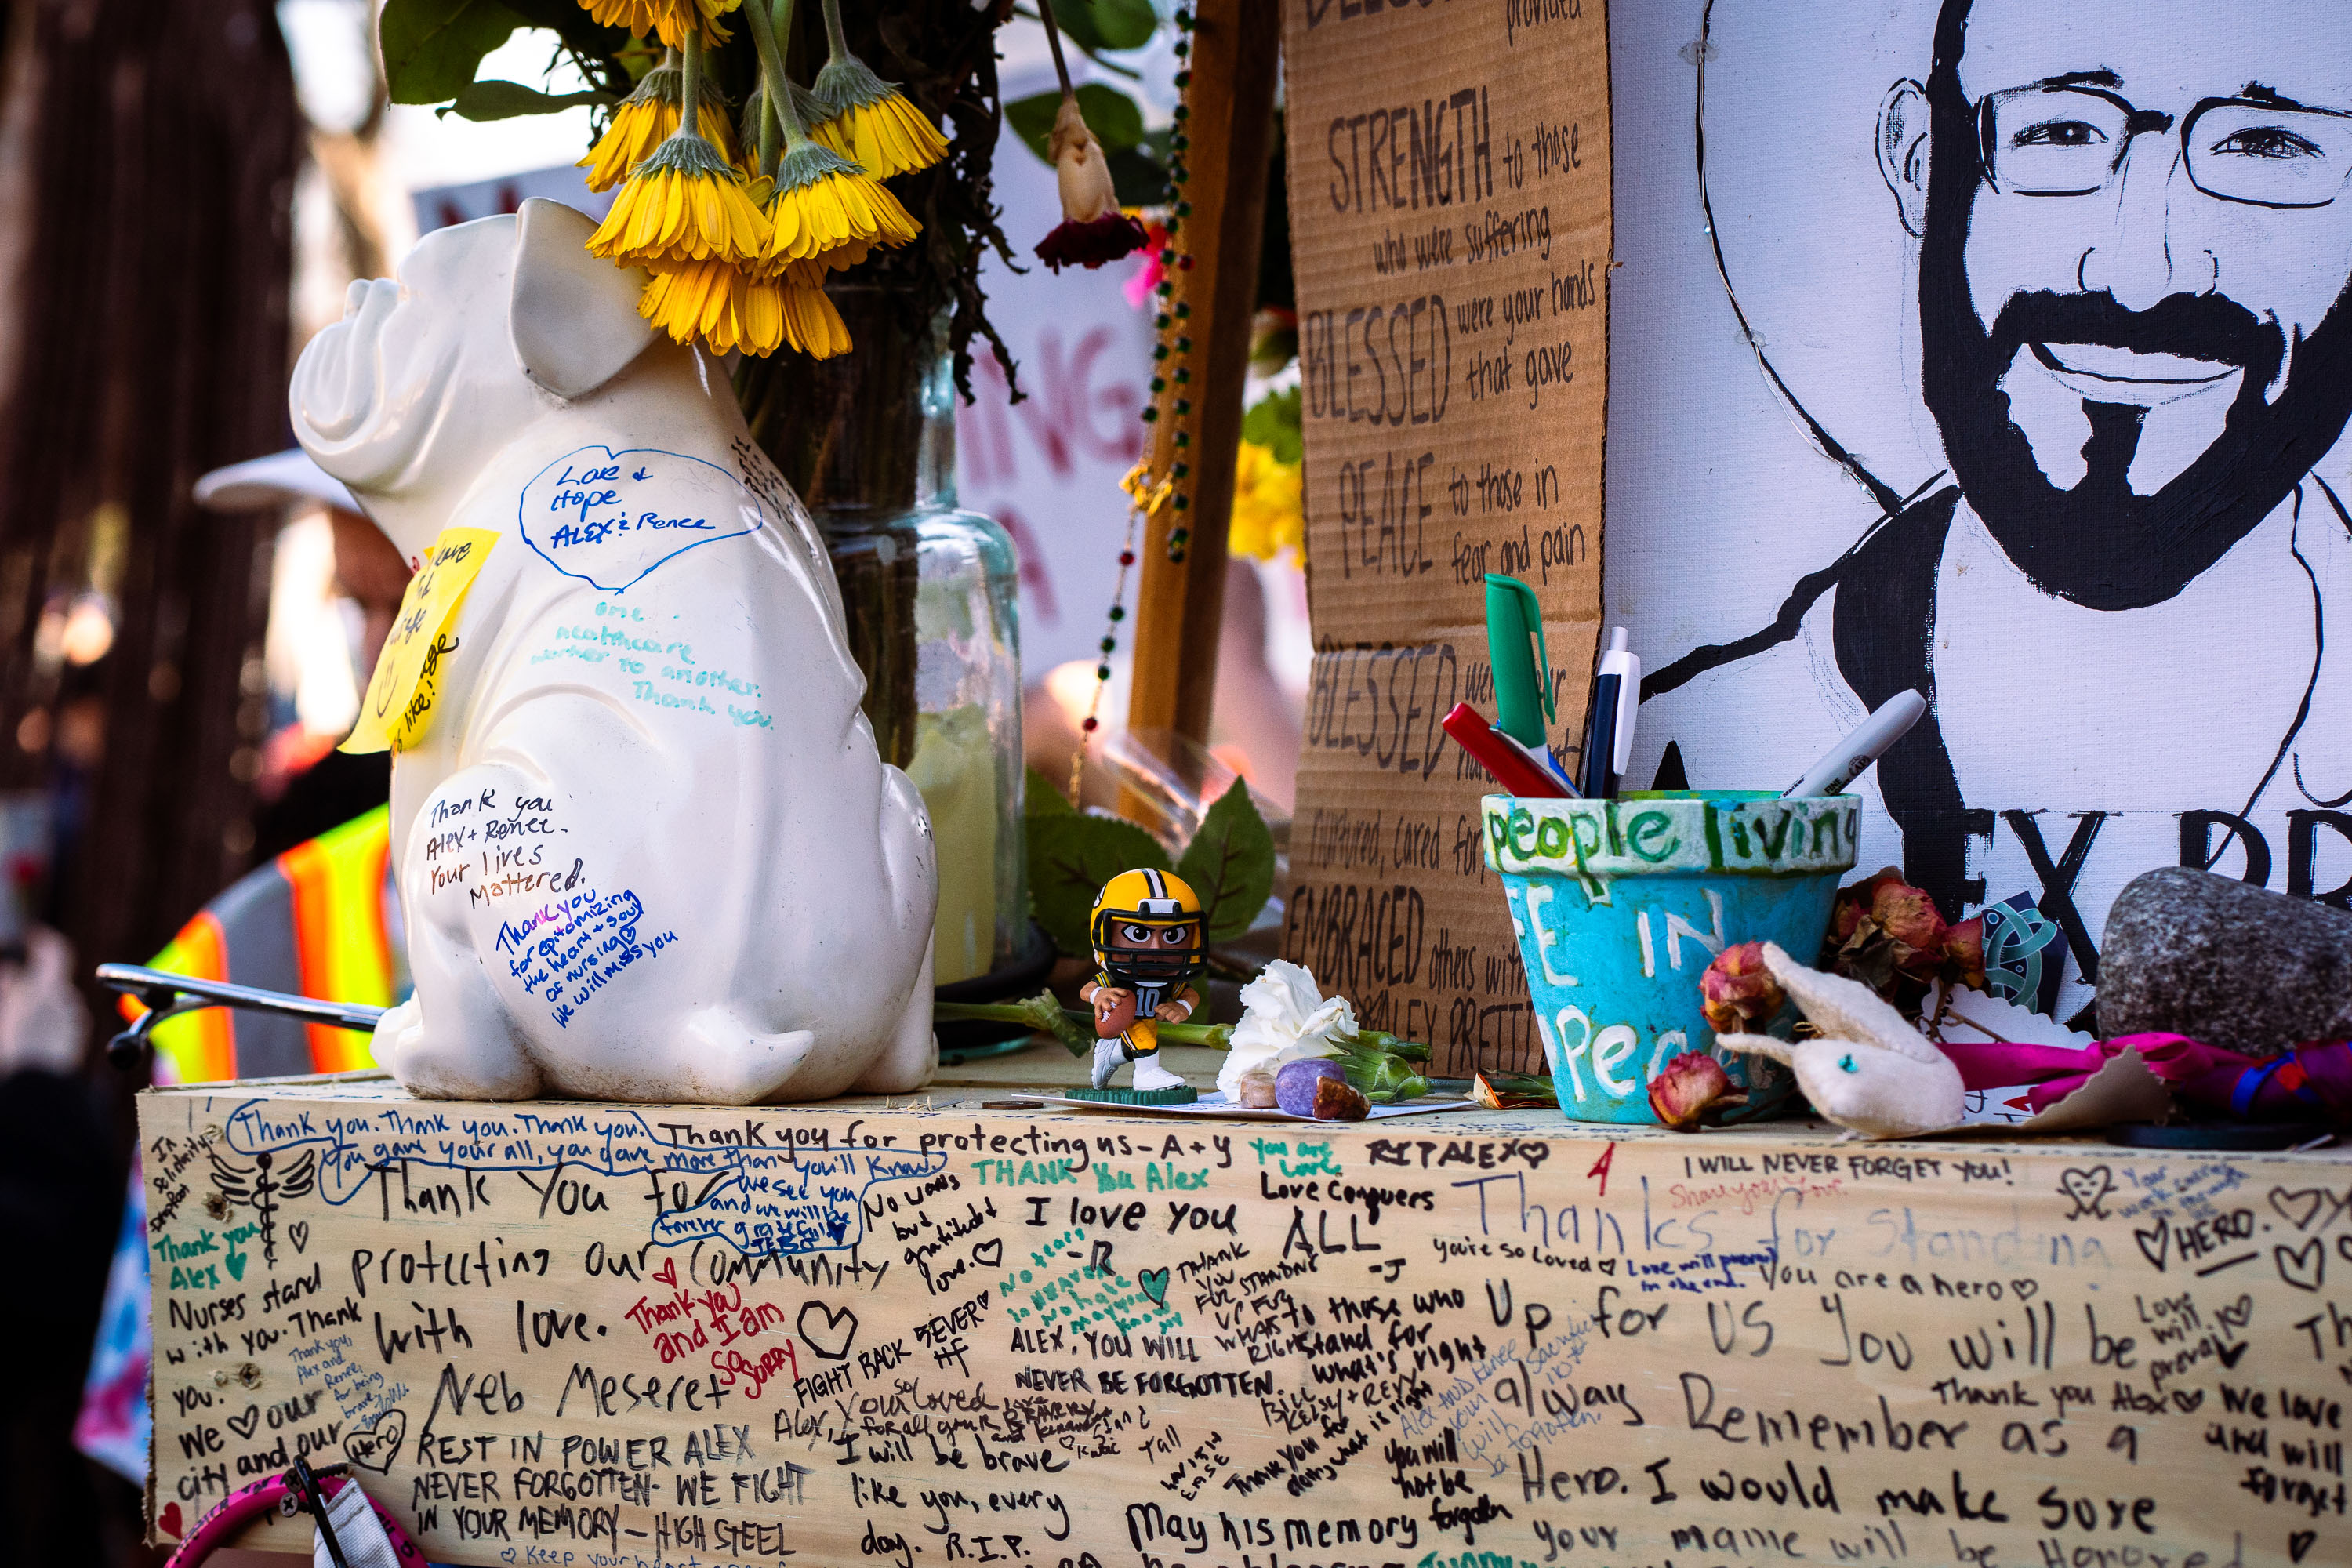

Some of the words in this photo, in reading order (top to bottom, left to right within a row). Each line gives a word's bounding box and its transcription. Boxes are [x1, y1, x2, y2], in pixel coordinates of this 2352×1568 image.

[1328, 85, 1493, 214] STRENGTH
[1504, 131, 1523, 189] to
[1531, 122, 1581, 179] those
[1374, 229, 1406, 275] who
[1415, 227, 1453, 271] were
[1466, 206, 1552, 260] suffering
[1307, 294, 1450, 426] BLESSED
[1457, 295, 1494, 336] were
[1504, 285, 1544, 345] your
[1552, 260, 1595, 315] hands
[1466, 350, 1512, 401] that
[1526, 341, 1573, 410] gave
[557, 466, 619, 486] Love
[551, 488, 623, 522] Hope
[1339, 452, 1434, 579] PEACE
[1449, 466, 1468, 516] to
[1476, 463, 1522, 512] those
[1534, 457, 1559, 510] in
[551, 520, 613, 549] ALEX
[1452, 531, 1491, 585] fear
[1501, 525, 1530, 575] and
[1541, 521, 1584, 586] pain
[633, 681, 715, 715] Thank
[1310, 634, 1457, 782] BLESSED
[1824, 777, 1842, 794] FINE
[431, 788, 495, 828] Thank
[508, 794, 553, 822] you
[426, 826, 465, 861] Alex
[482, 844, 543, 875] lives
[1394, 815, 1441, 870] cared
[1488, 805, 1681, 896] people
[1704, 797, 1858, 868] living
[470, 858, 585, 909] Mattered.
[495, 903, 559, 955] Thank
[539, 889, 642, 959] epitomizing
[1286, 884, 1424, 992] EMBRACED
[1428, 928, 1476, 996] others
[1637, 887, 1726, 978] IN
[551, 931, 592, 973] heart
[567, 935, 627, 986] nursing
[552, 1004, 575, 1029] We
[575, 975, 607, 1006] will
[604, 945, 644, 979] miss
[642, 931, 679, 959] you
[1137, 988, 1160, 1018] 10
[235, 1110, 316, 1147] Thank
[376, 1110, 450, 1134] Thank
[514, 1113, 588, 1135] Thank
[658, 1118, 765, 1149] Thank
[776, 1126, 829, 1163] you
[841, 1119, 898, 1149] for
[920, 1120, 1091, 1173] protecting
[505, 1139, 542, 1165] all,
[1698, 1156, 1754, 1175] WILL
[1761, 1153, 1839, 1175] NEVER
[1847, 1156, 1942, 1181] FORGET
[365, 1159, 493, 1221] Thank
[517, 1161, 609, 1219] You
[771, 1179, 810, 1201] see
[820, 1185, 858, 1210] you
[971, 1158, 1079, 1188] THANK
[1145, 1161, 1210, 1192] Alex
[1261, 1171, 1320, 1202] Love
[710, 1194, 751, 1214] and
[784, 1205, 820, 1220] will
[863, 1193, 898, 1232] No
[1025, 1197, 1052, 1226] I
[1070, 1195, 1146, 1231] love
[153, 1229, 220, 1263] Thank
[1282, 1205, 1381, 1259] ALL
[2174, 1208, 2271, 1261] HERO.
[168, 1292, 247, 1330] Nurses
[263, 1261, 322, 1315] stand
[170, 1264, 221, 1290] Alex
[1835, 1269, 1889, 1288] are
[1933, 1273, 2004, 1301] hero
[289, 1298, 363, 1339] Thank
[1412, 1288, 1465, 1315] who
[372, 1298, 474, 1367] with
[516, 1298, 608, 1354] love.
[1010, 1327, 1077, 1357] ALEX,
[1091, 1327, 1133, 1359] YOU
[1142, 1335, 1202, 1363] WILL
[1388, 1319, 1432, 1350] for
[1594, 1284, 1670, 1340] for
[1949, 1298, 2055, 1370] will
[2085, 1303, 2136, 1367] be
[793, 1361, 857, 1410] FIGHT
[857, 1338, 913, 1380] BACK
[1413, 1334, 1486, 1374] right
[172, 1385, 226, 1420] you.
[1016, 1370, 1091, 1396] NEVER
[1100, 1372, 1128, 1396] BE
[1135, 1370, 1286, 1399] FORGOTTEN.
[1931, 1377, 2040, 1407] Thank
[2049, 1384, 2096, 1418] you
[176, 1424, 225, 1461] We
[266, 1390, 326, 1436] our
[1679, 1370, 1969, 1454] Remember
[2002, 1418, 2068, 1457] as
[2279, 1387, 2343, 1430] love
[237, 1437, 290, 1477] and
[296, 1420, 343, 1463] our
[416, 1428, 487, 1468] REST
[511, 1432, 543, 1463] IN
[562, 1435, 672, 1472] POWER
[684, 1424, 755, 1469] ALEX
[869, 1434, 915, 1464] will
[933, 1436, 969, 1470] be
[980, 1439, 1070, 1475] brave
[2281, 1439, 2343, 1476] will
[412, 1470, 500, 1512] NEVER
[675, 1472, 720, 1507] WE
[731, 1461, 816, 1507] FIGHT
[851, 1470, 908, 1508] like
[923, 1488, 980, 1536] you,
[988, 1493, 1071, 1541] every
[1517, 1446, 1629, 1504] Hero.
[1645, 1457, 1679, 1505] I
[1700, 1460, 1841, 1514] would
[1876, 1469, 2009, 1524] make
[417, 1504, 437, 1536] IN
[453, 1505, 509, 1542] YOUR
[518, 1504, 619, 1555] MEMORY
[655, 1511, 706, 1559] HIGH
[714, 1513, 796, 1558] STEEL
[860, 1520, 922, 1556] day.
[1126, 1501, 1209, 1553] May
[1221, 1512, 1276, 1550] his
[1285, 1517, 1418, 1550] memory
[1534, 1519, 1618, 1563] your
[1830, 1519, 1907, 1561] will
[525, 1545, 575, 1567] Keep
